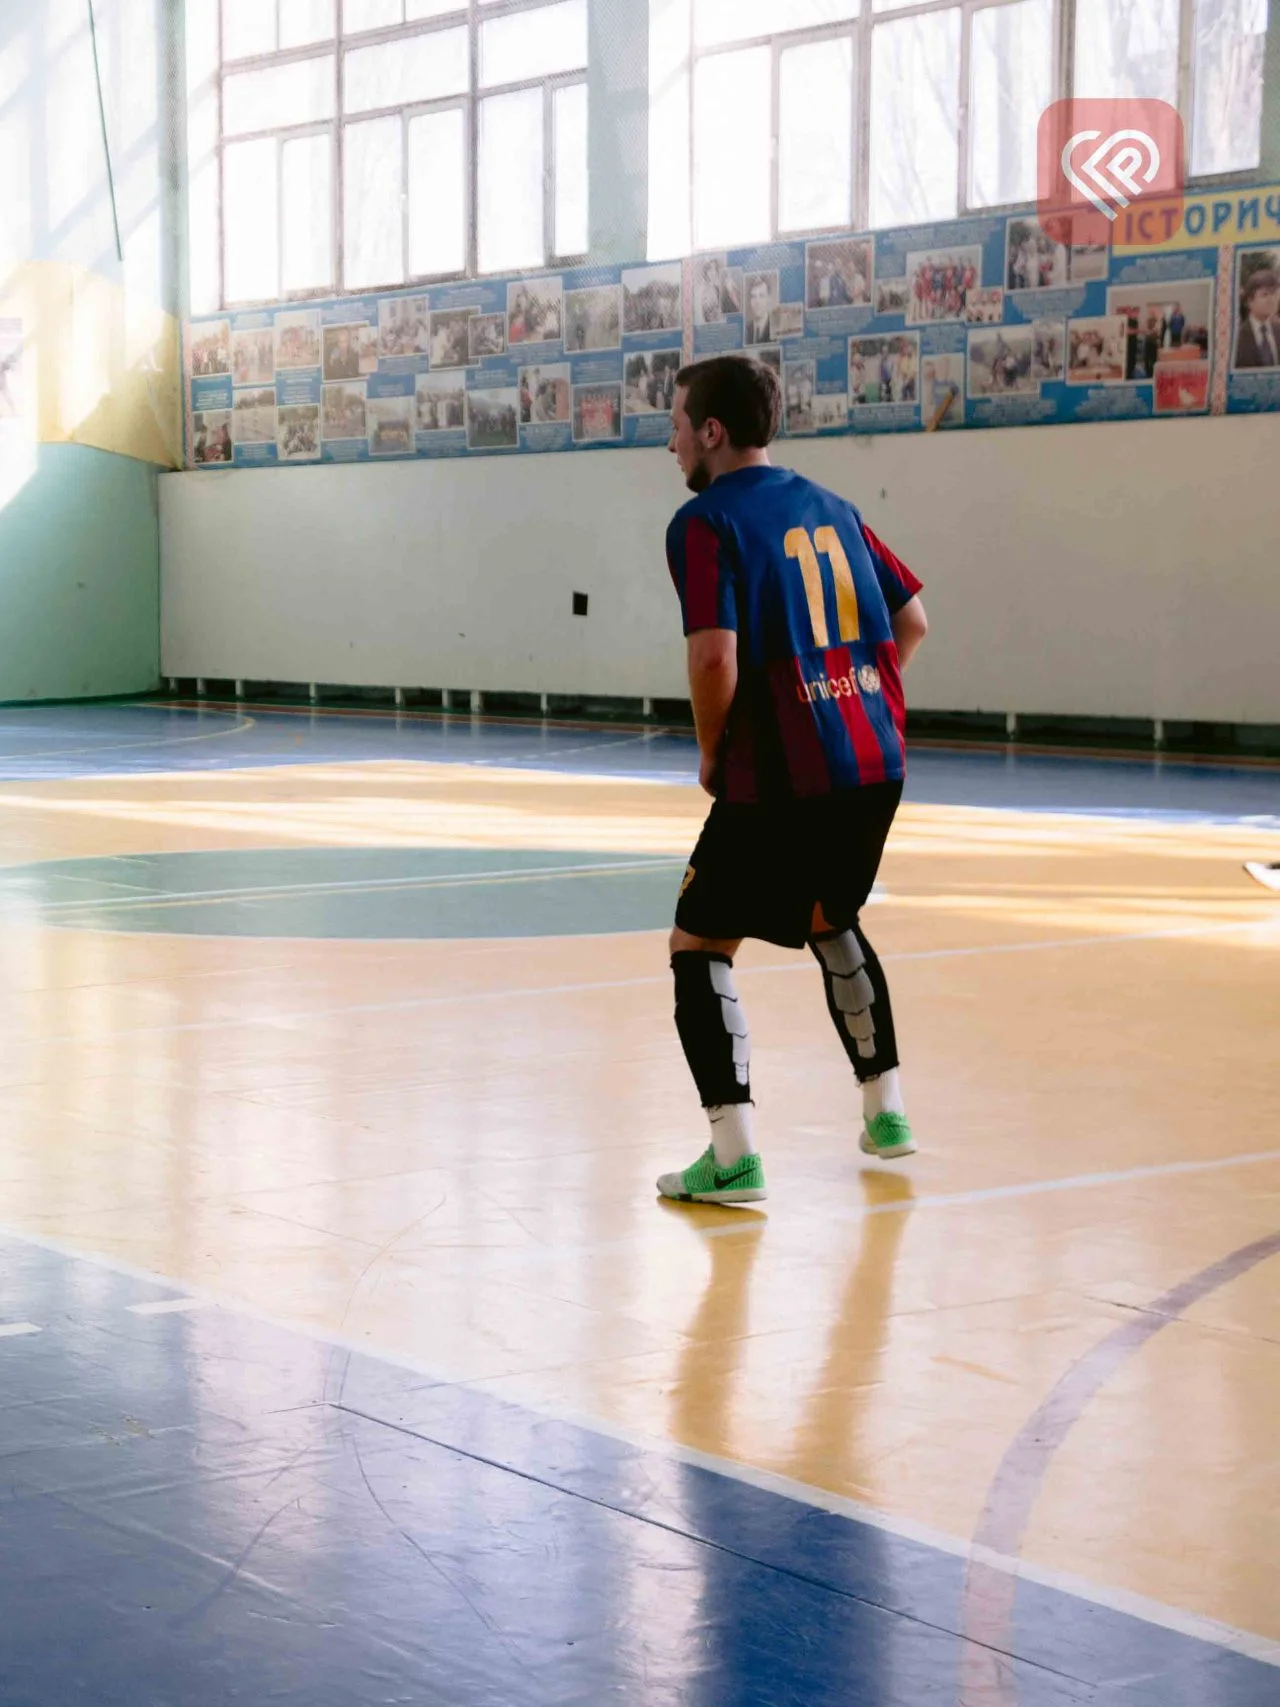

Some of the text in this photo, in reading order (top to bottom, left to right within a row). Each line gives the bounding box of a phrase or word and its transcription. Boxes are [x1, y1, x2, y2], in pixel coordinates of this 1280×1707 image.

[1125, 193, 1280, 242] ІСТОРИЧ
[784, 525, 860, 647] 11
[796, 667, 857, 703] unicef
